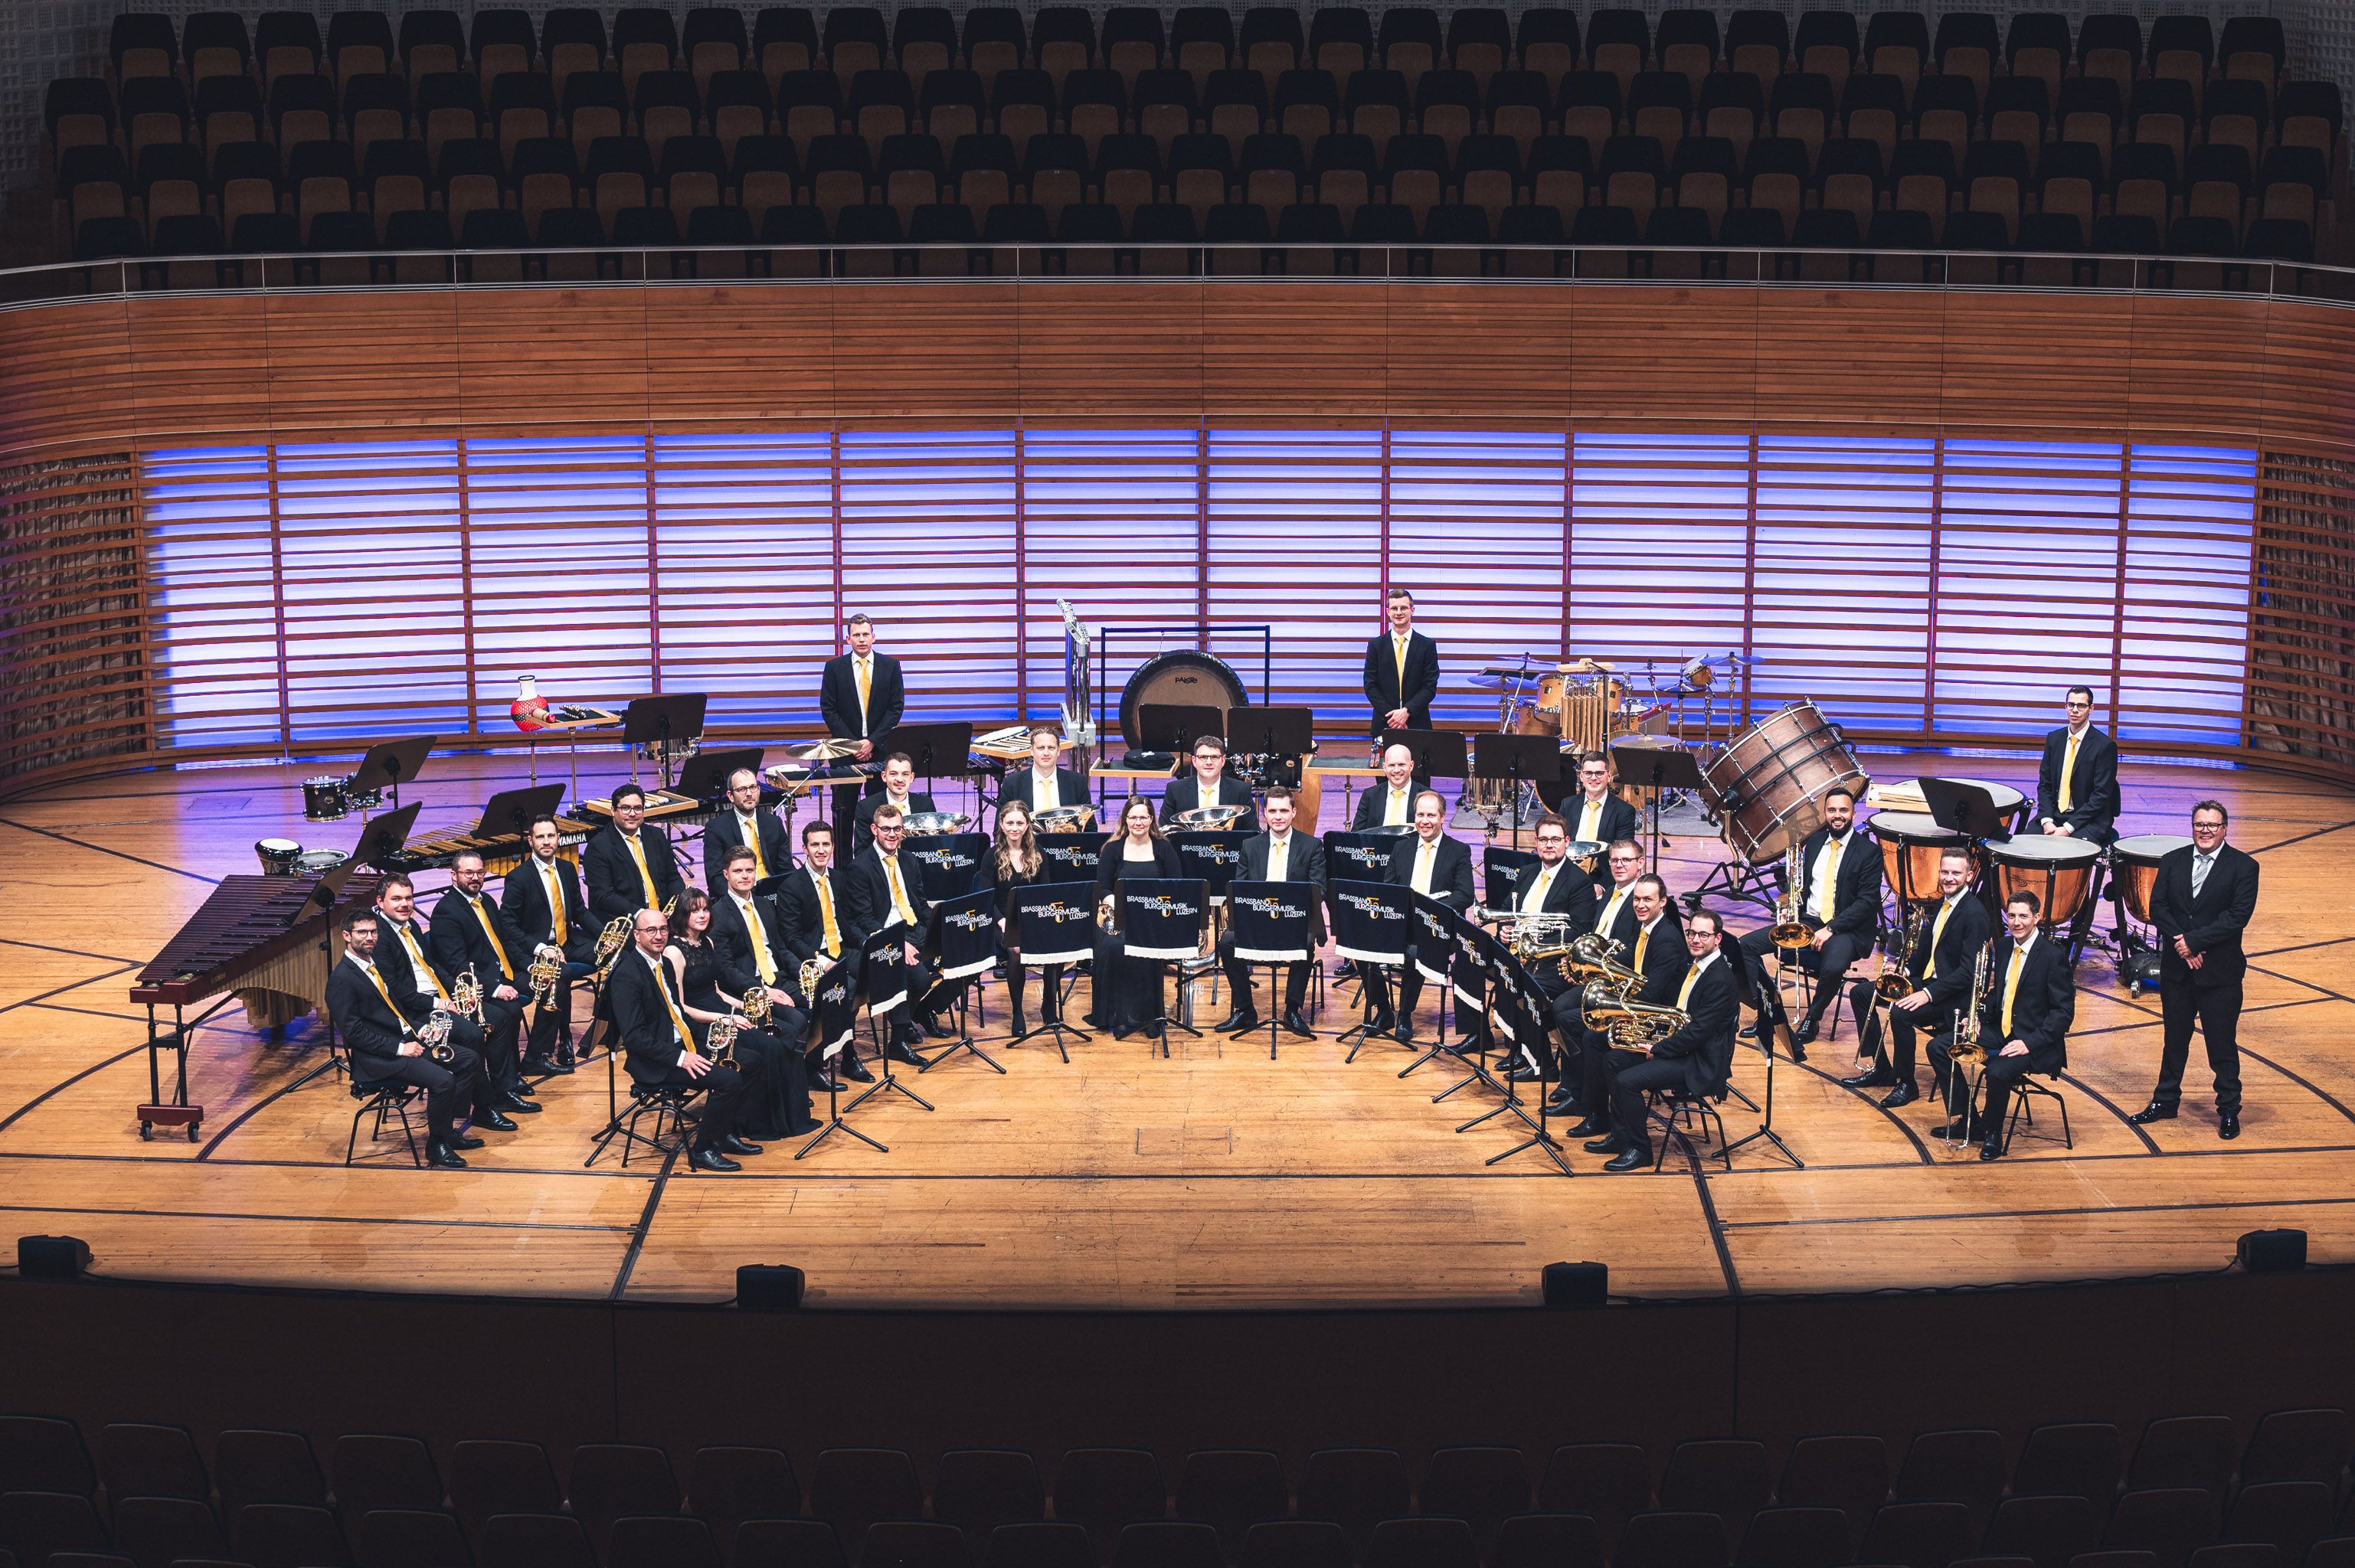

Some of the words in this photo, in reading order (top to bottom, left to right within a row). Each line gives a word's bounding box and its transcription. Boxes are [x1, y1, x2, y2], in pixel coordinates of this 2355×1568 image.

[558, 833, 587, 846] YAMAHA
[1335, 845, 1367, 855] BRASSBAND
[912, 851, 943, 859] ASSBAND
[955, 858, 974, 867] LUZERN
[1127, 895, 1163, 904] BRASSBAND
[1235, 897, 1271, 906] BRASSBAND
[1339, 893, 1371, 905] BRASSBAND
[1021, 905, 1055, 913] BRASSBAND
[1176, 907, 1198, 916] LUZERN
[1069, 911, 1090, 920] LUZERN
[1284, 910, 1307, 918] LUZERN
